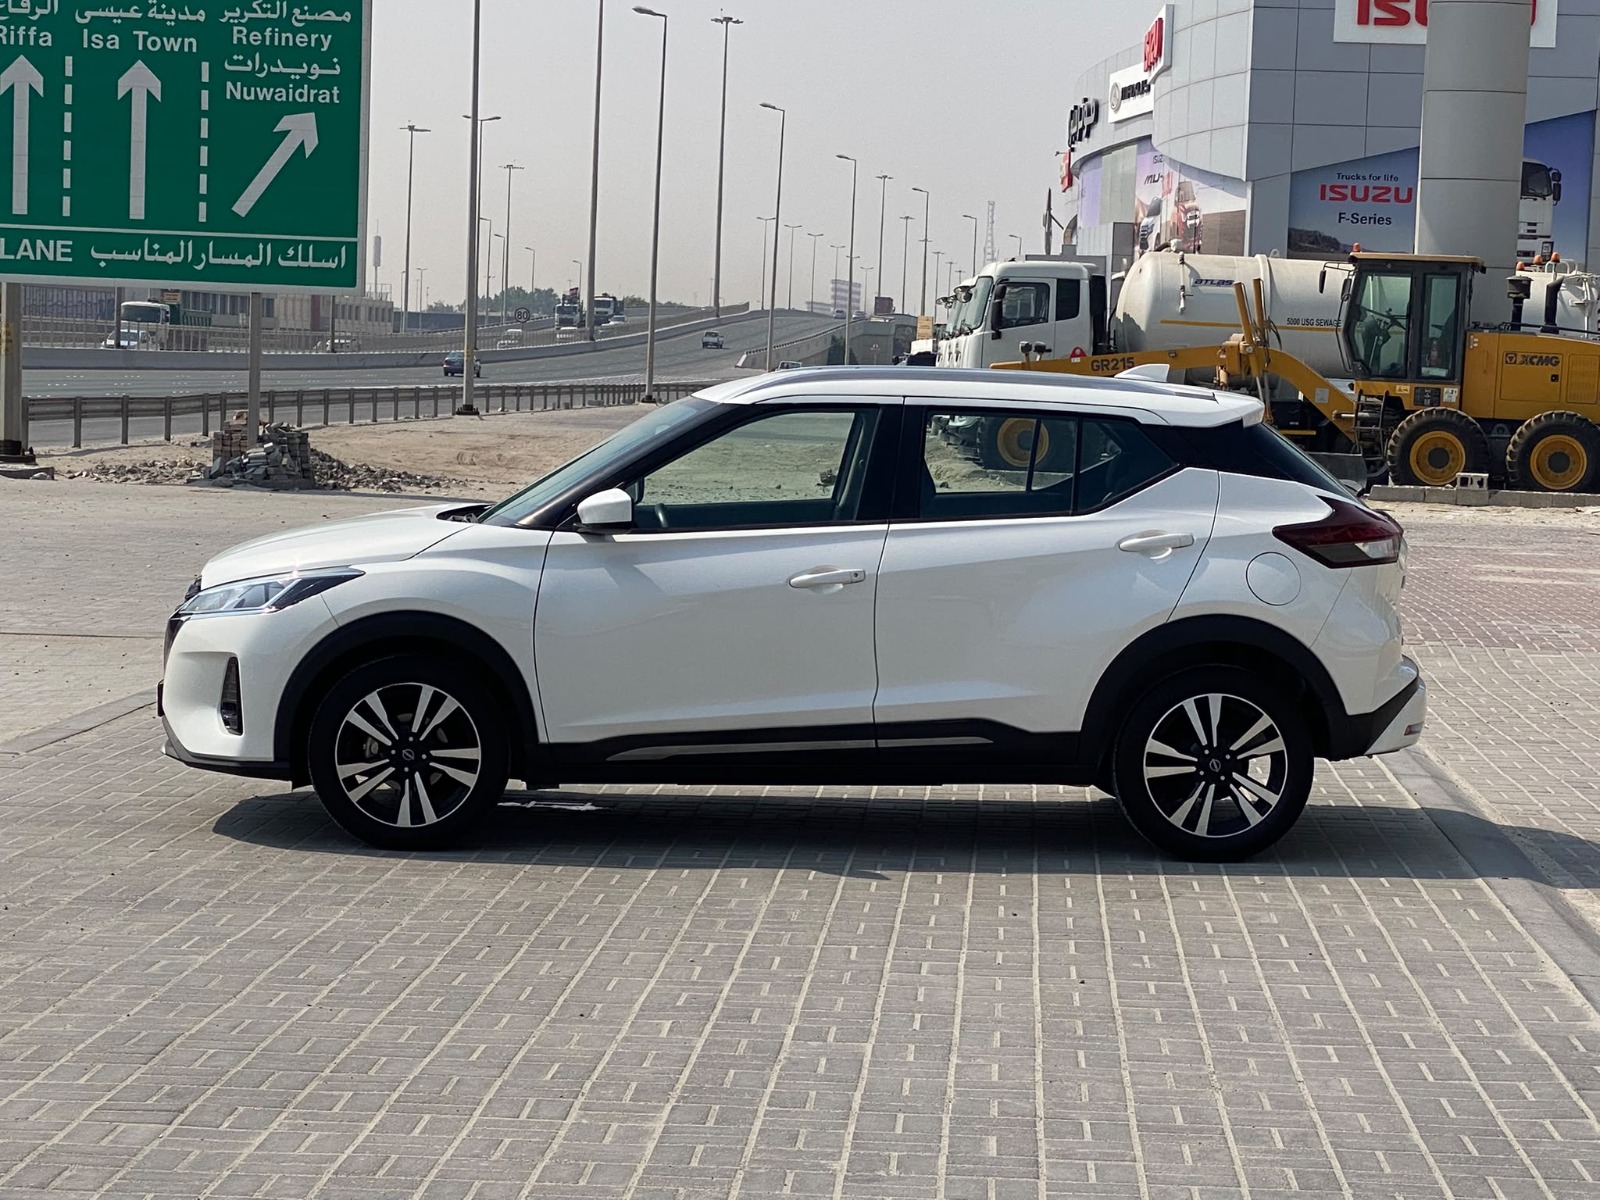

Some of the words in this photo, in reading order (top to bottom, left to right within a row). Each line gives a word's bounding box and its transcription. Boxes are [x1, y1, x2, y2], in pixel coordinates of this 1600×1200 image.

[75, 5, 143, 24] عيسى
[147, 0, 206, 26] مدينة
[219, 0, 287, 24] التكرير
[291, 5, 352, 27] مصنع
[82, 28, 120, 49] Isa
[132, 30, 197, 53] Town
[232, 26, 332, 51] Refinery
[224, 52, 341, 80] نويدرات
[226, 81, 340, 104] Nuwaidrat
[1337, 172, 1366, 181] Trucks
[1369, 173, 1381, 181] for
[1384, 174, 1399, 182] life
[1320, 184, 1413, 204] ISUZU
[1338, 212, 1392, 225] F-Series
[0, 237, 73, 262] LANE
[277, 243, 346, 269] اسلك
[517, 311, 528, 320] 80
[1286, 317, 1300, 326] 5000
[1301, 318, 1314, 327] USG
[1091, 356, 1135, 371] GR215
[1518, 354, 1560, 367] XCMG
